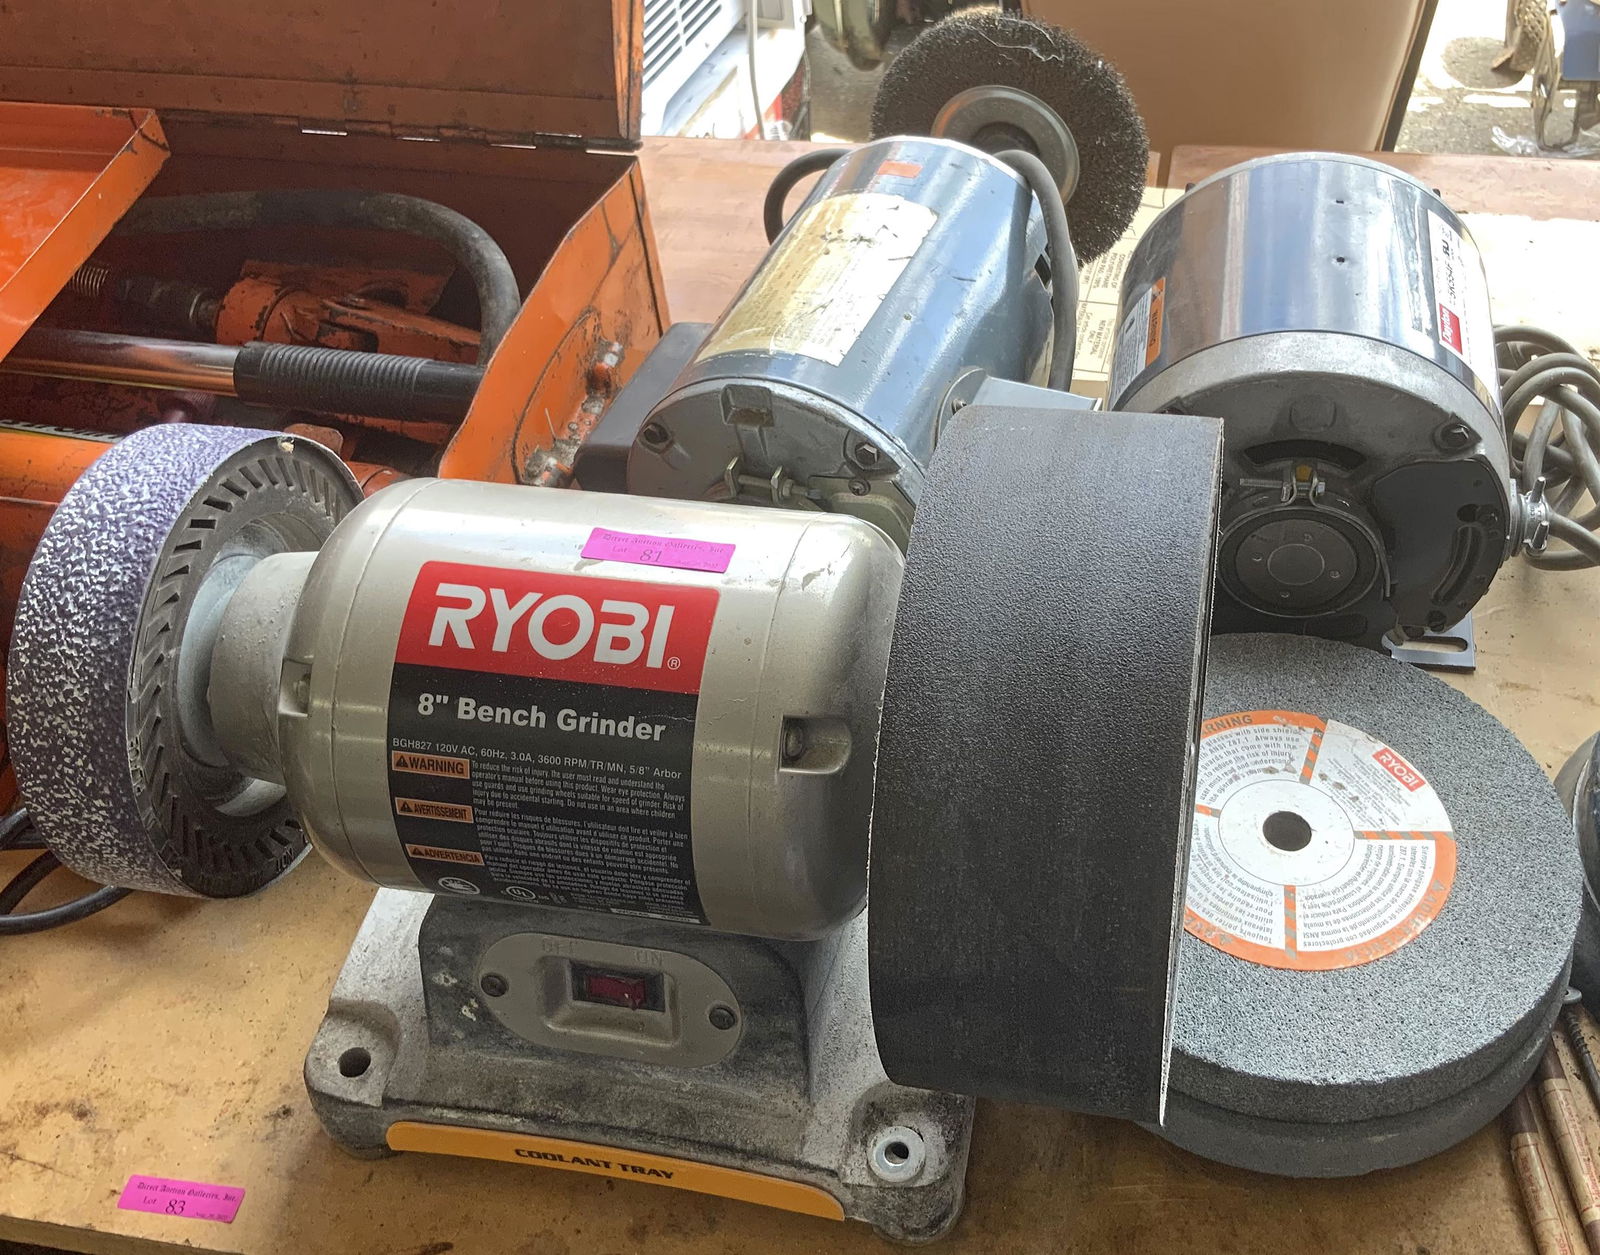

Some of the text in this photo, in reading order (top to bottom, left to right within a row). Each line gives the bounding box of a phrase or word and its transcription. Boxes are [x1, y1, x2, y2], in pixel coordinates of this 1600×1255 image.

[640, 549, 663, 563] 81
[428, 583, 675, 669] RYOBI
[417, 693, 666, 741] 8" Bench Grinder
[1203, 715, 1252, 734] RNING
[1255, 734, 1283, 742] Always
[392, 737, 682, 780] BGH827 120V AC, 60Hz, 3.0A, 3600 RPM/TR/MN, 5/8" Arbor
[408, 757, 464, 775] WARNING
[1212, 759, 1233, 772] reduce
[1246, 751, 1259, 759] risk
[480, 762, 500, 771] reduce
[501, 763, 511, 772] the
[512, 765, 523, 773] risk
[551, 770, 560, 778] the
[620, 779, 654, 789] understand
[655, 782, 665, 790] the
[1378, 752, 1418, 789] RYOBI
[567, 799, 575, 807] Do
[663, 801, 675, 810] Risk
[664, 792, 685, 803] Always
[414, 803, 467, 820] AVERTISSEMENT
[424, 848, 480, 863] ADVERTENCIA
[1254, 905, 1272, 915] Pour
[1358, 918, 1387, 937] seguridad
[515, 1149, 674, 1179] COOLANT TRAY
[138, 1182, 158, 1191] Direct
[160, 1185, 185, 1195] Auction
[144, 1196, 186, 1215] Lot 83
